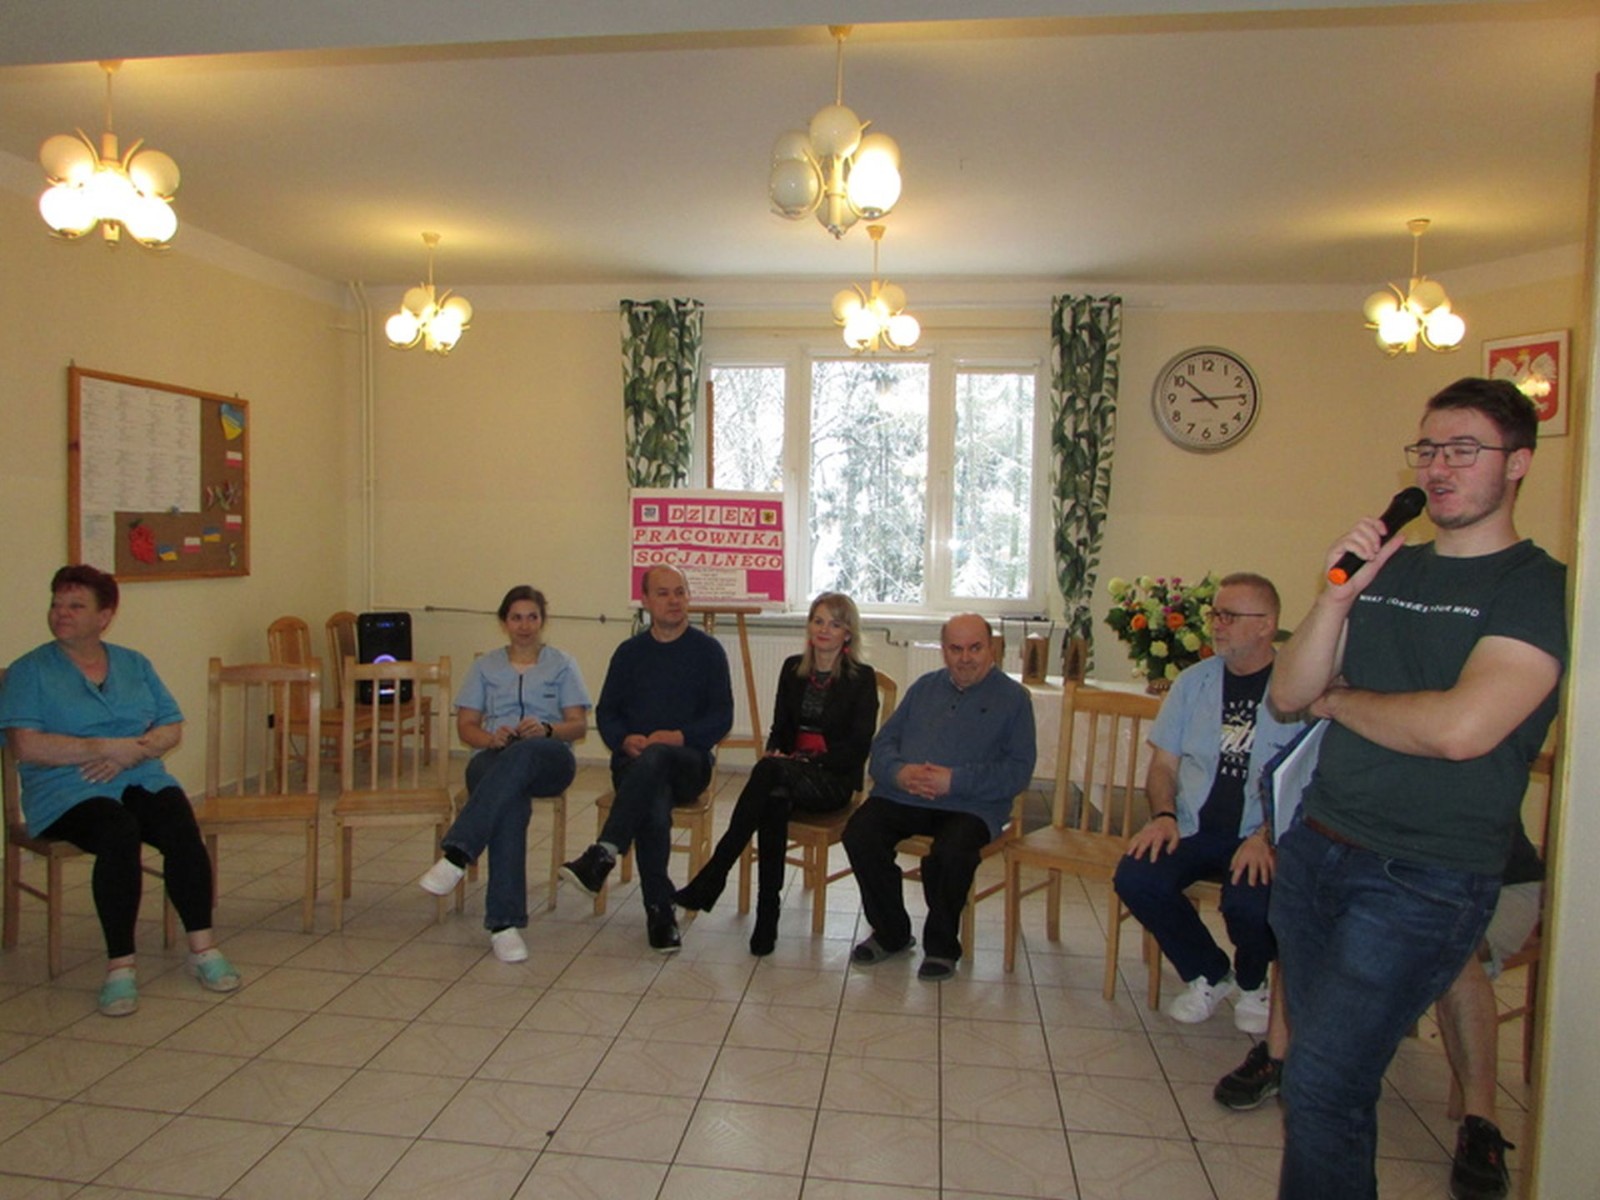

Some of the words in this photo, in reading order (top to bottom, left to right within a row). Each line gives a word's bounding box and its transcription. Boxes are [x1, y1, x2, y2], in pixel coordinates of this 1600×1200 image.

[1188, 364, 1195, 376] 11
[1202, 359, 1215, 372] 12
[1174, 375, 1186, 388] 10
[1234, 375, 1243, 388] 2
[1167, 393, 1177, 405] 9
[1238, 394, 1247, 406] 3
[1172, 410, 1182, 423] 8
[1232, 412, 1242, 423] 4
[1187, 423, 1196, 434] 7
[1201, 427, 1211, 440] 6
[1220, 423, 1229, 435] 5
[634, 529, 781, 547] PRACOWNIKA
[635, 551, 781, 569] SOCJALNEGO
